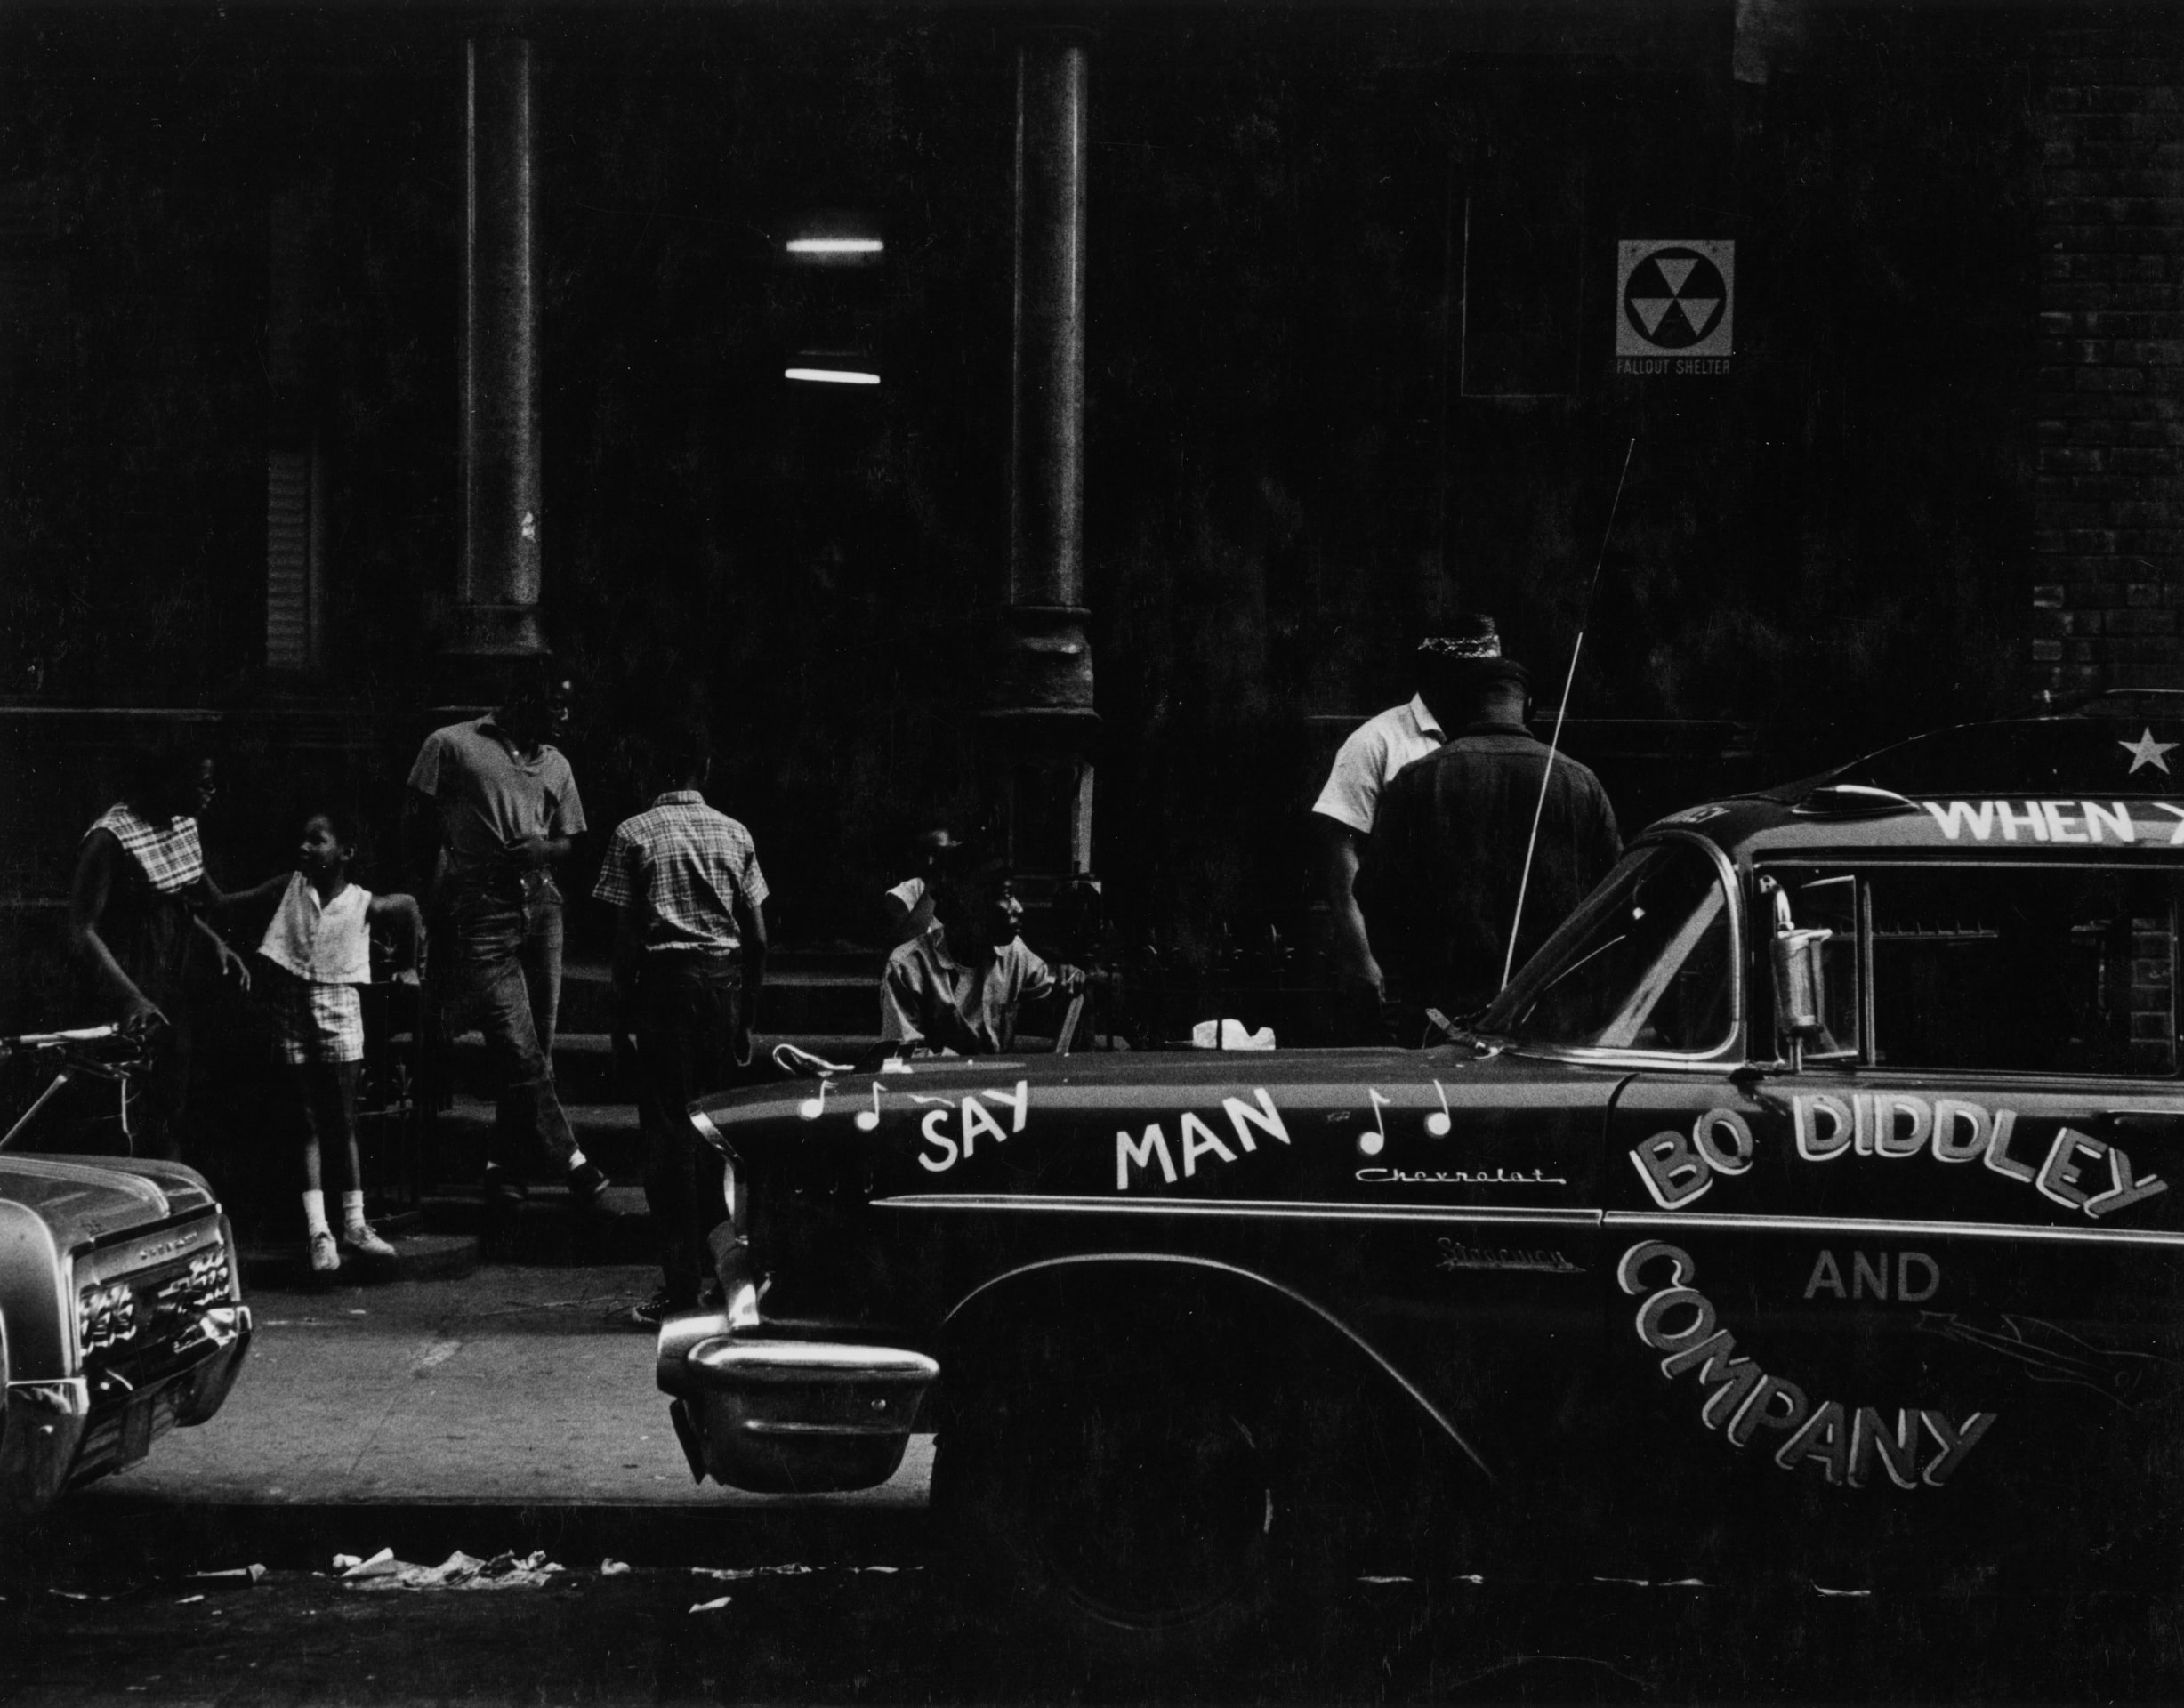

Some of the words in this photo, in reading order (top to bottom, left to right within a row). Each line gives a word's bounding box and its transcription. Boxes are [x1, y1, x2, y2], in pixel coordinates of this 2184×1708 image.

[1616, 359, 1670, 375] FALLOUT
[1676, 359, 1730, 375] SHELTER
[1922, 800, 2135, 842] WHEN
[918, 1079, 1028, 1172] SAY
[1116, 1087, 1291, 1190] MAN
[1629, 1108, 1753, 1210] BO
[1793, 1093, 2169, 1218] DIDDLEY
[1355, 1167, 1567, 1185] Chevrolet
[1803, 1249, 1941, 1301] AND
[1617, 1239, 1999, 1490] COMPANY
